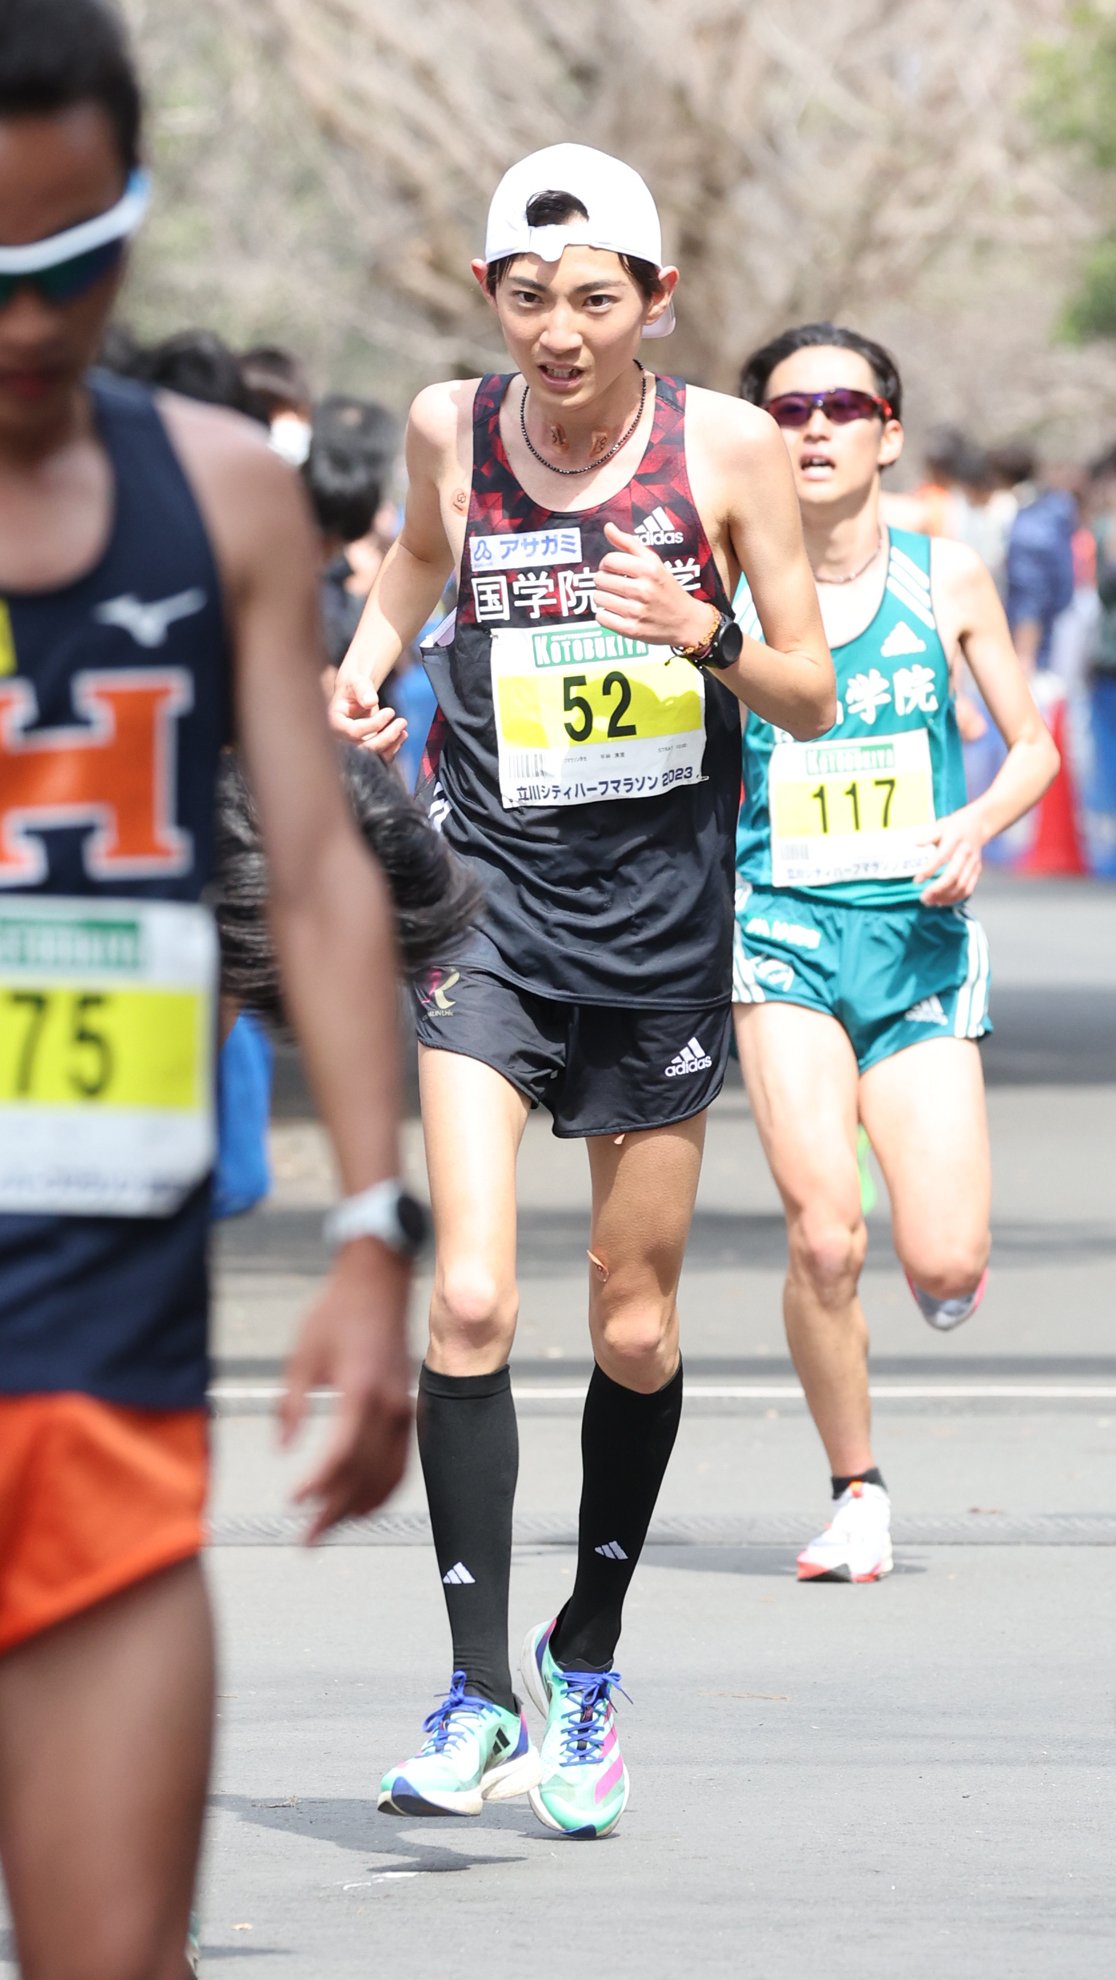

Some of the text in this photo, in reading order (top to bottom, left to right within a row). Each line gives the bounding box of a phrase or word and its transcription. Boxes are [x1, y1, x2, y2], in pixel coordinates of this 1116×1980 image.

[500, 534, 577, 560] アサガミ
[471, 556, 701, 623] 国学院学
[563, 671, 637, 742] 52
[516, 766, 693, 801] 立川シティハーフマラソン 2023
[812, 779, 897, 834] 117
[664, 1056, 712, 1078] adidas
